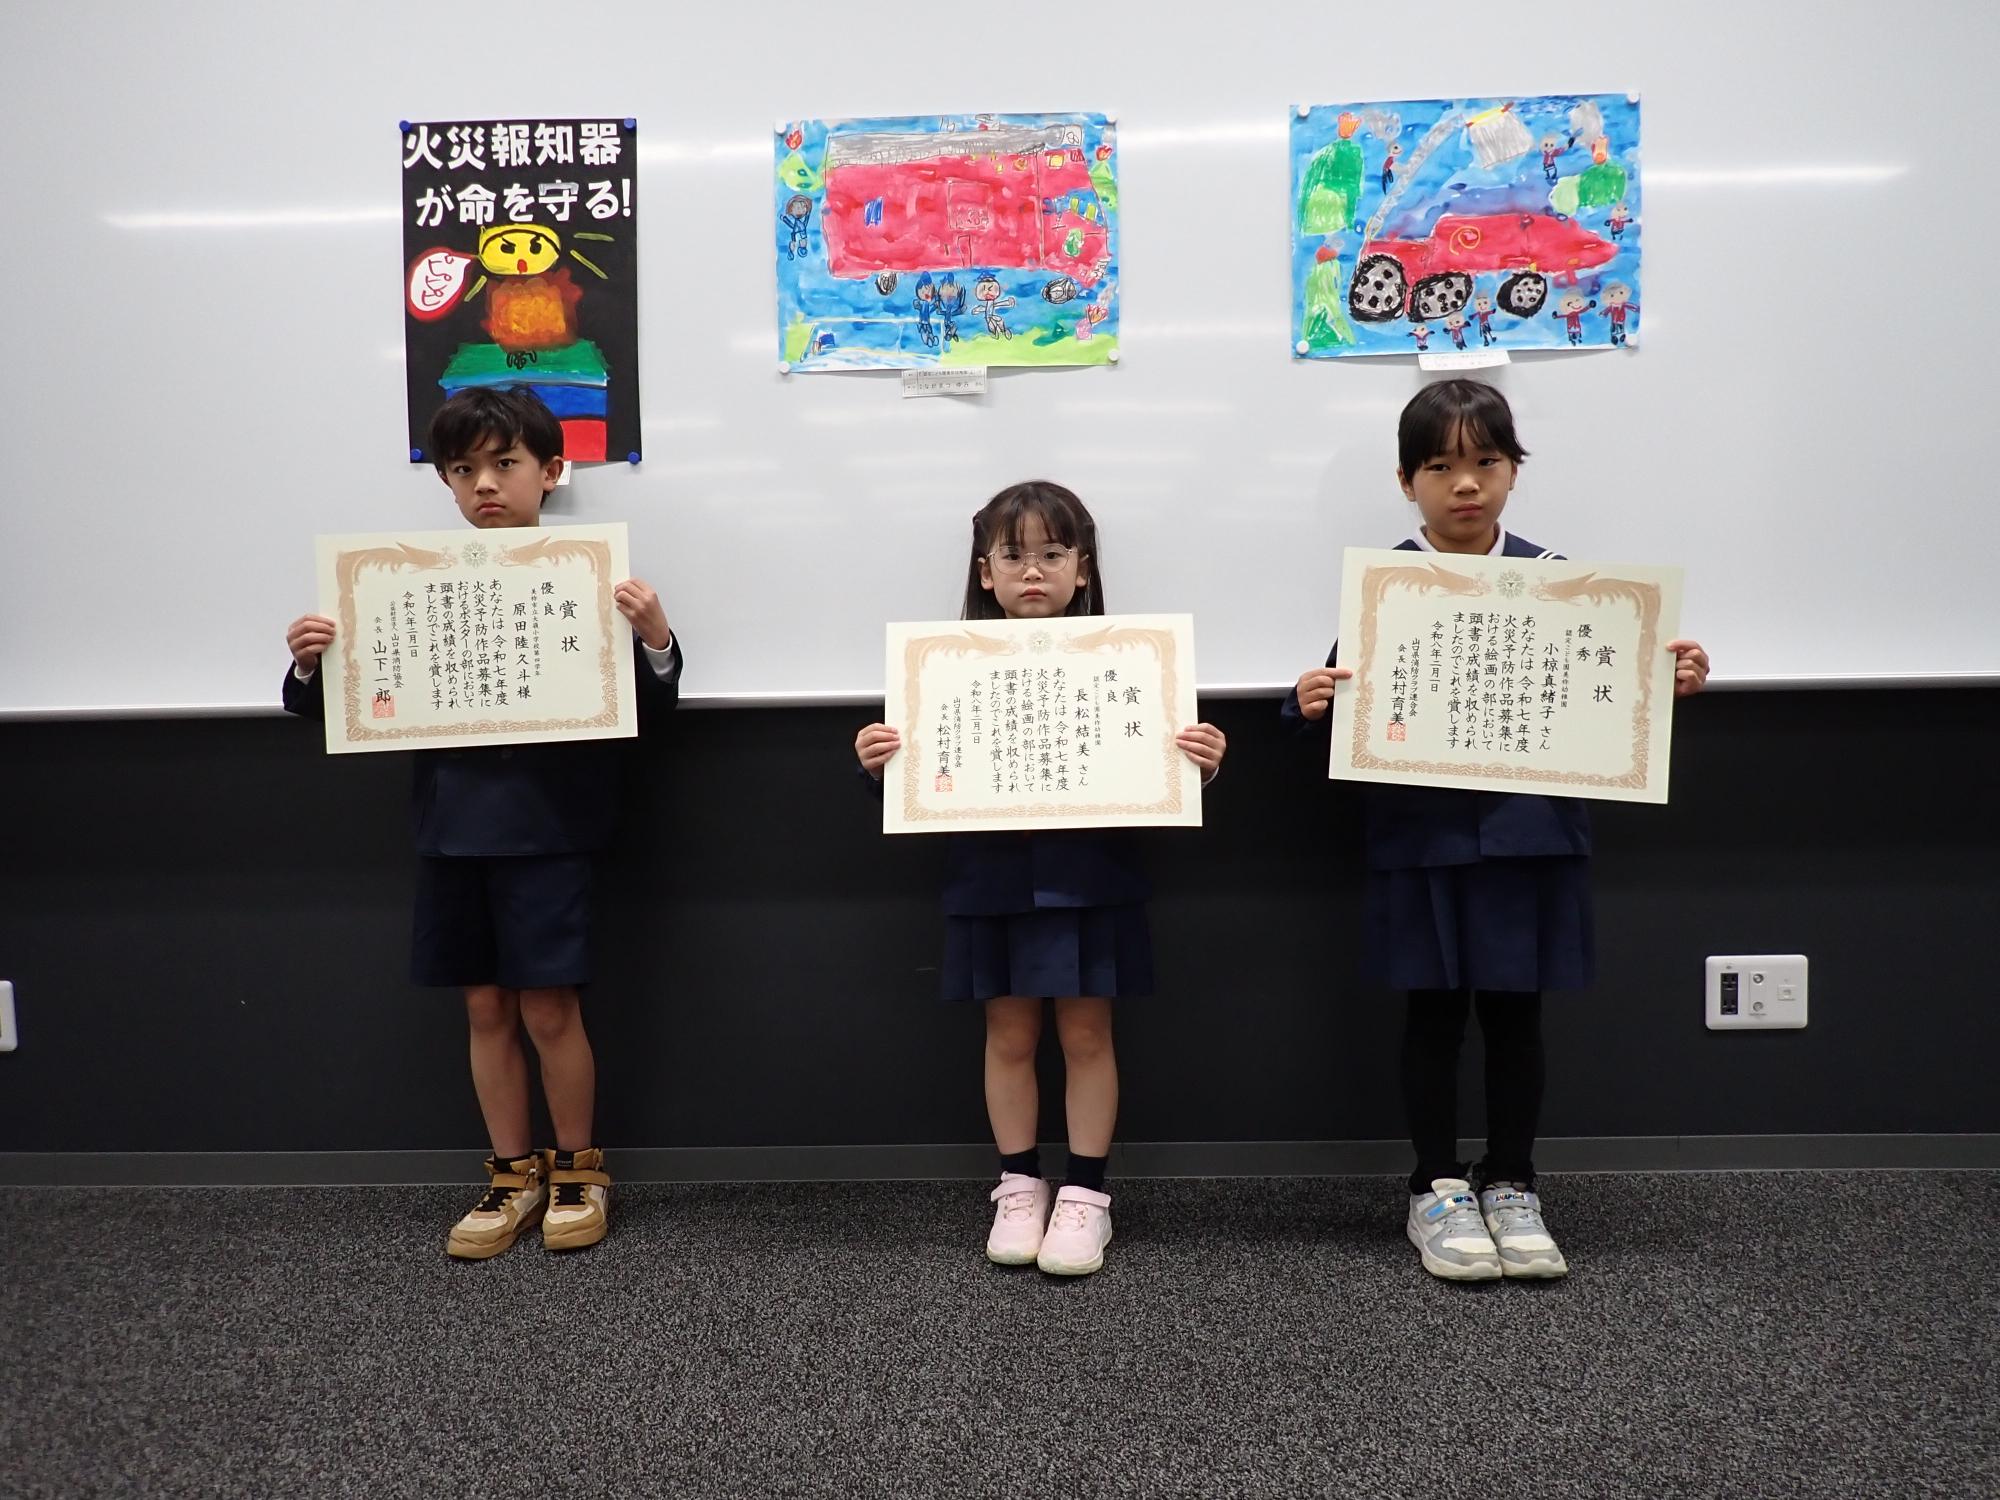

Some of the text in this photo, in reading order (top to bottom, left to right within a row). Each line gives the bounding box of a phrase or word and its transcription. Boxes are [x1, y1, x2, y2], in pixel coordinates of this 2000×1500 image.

[403, 123, 621, 170] 火災報知器
[415, 178, 631, 226] が命を守る!
[373, 615, 384, 634] 会長
[402, 590, 420, 658] 令和八年二月一日
[540, 581, 556, 616] 優良
[558, 599, 581, 653] 賞状
[423, 582, 444, 711] ましたのでこれを賞します
[439, 582, 461, 710] 頭書の成績を収められ
[457, 580, 475, 708] おけるポスターの部において
[471, 580, 493, 708] 火災予防作品募集に
[1396, 643, 1408, 664] 会長
[1429, 620, 1445, 693] 令和八年二月一日
[1576, 623, 1593, 662] 優秀
[1592, 645, 1617, 704] 賞状
[940, 703, 949, 721] 会長
[970, 679, 983, 744] 令和八年二月一日
[1103, 669, 1119, 703] 優良
[1122, 686, 1144, 739] 賞状
[1388, 665, 1408, 729] 松村育美
[1445, 611, 1465, 749] ましたのでこれを賞します
[1464, 612, 1485, 750] 頭書の成績を収められ
[1481, 612, 1501, 751] おける絵画の部において
[1497, 614, 1519, 752] 火災予防作品募集に
[935, 723, 953, 781] 松村育美
[989, 670, 1004, 794] ましたのでこれを賞します
[1003, 669, 1021, 793] 頭書の成績を収められ
[1020, 668, 1036, 793] おける絵画の部において
[1036, 668, 1053, 792] 火災予防作品募集に
